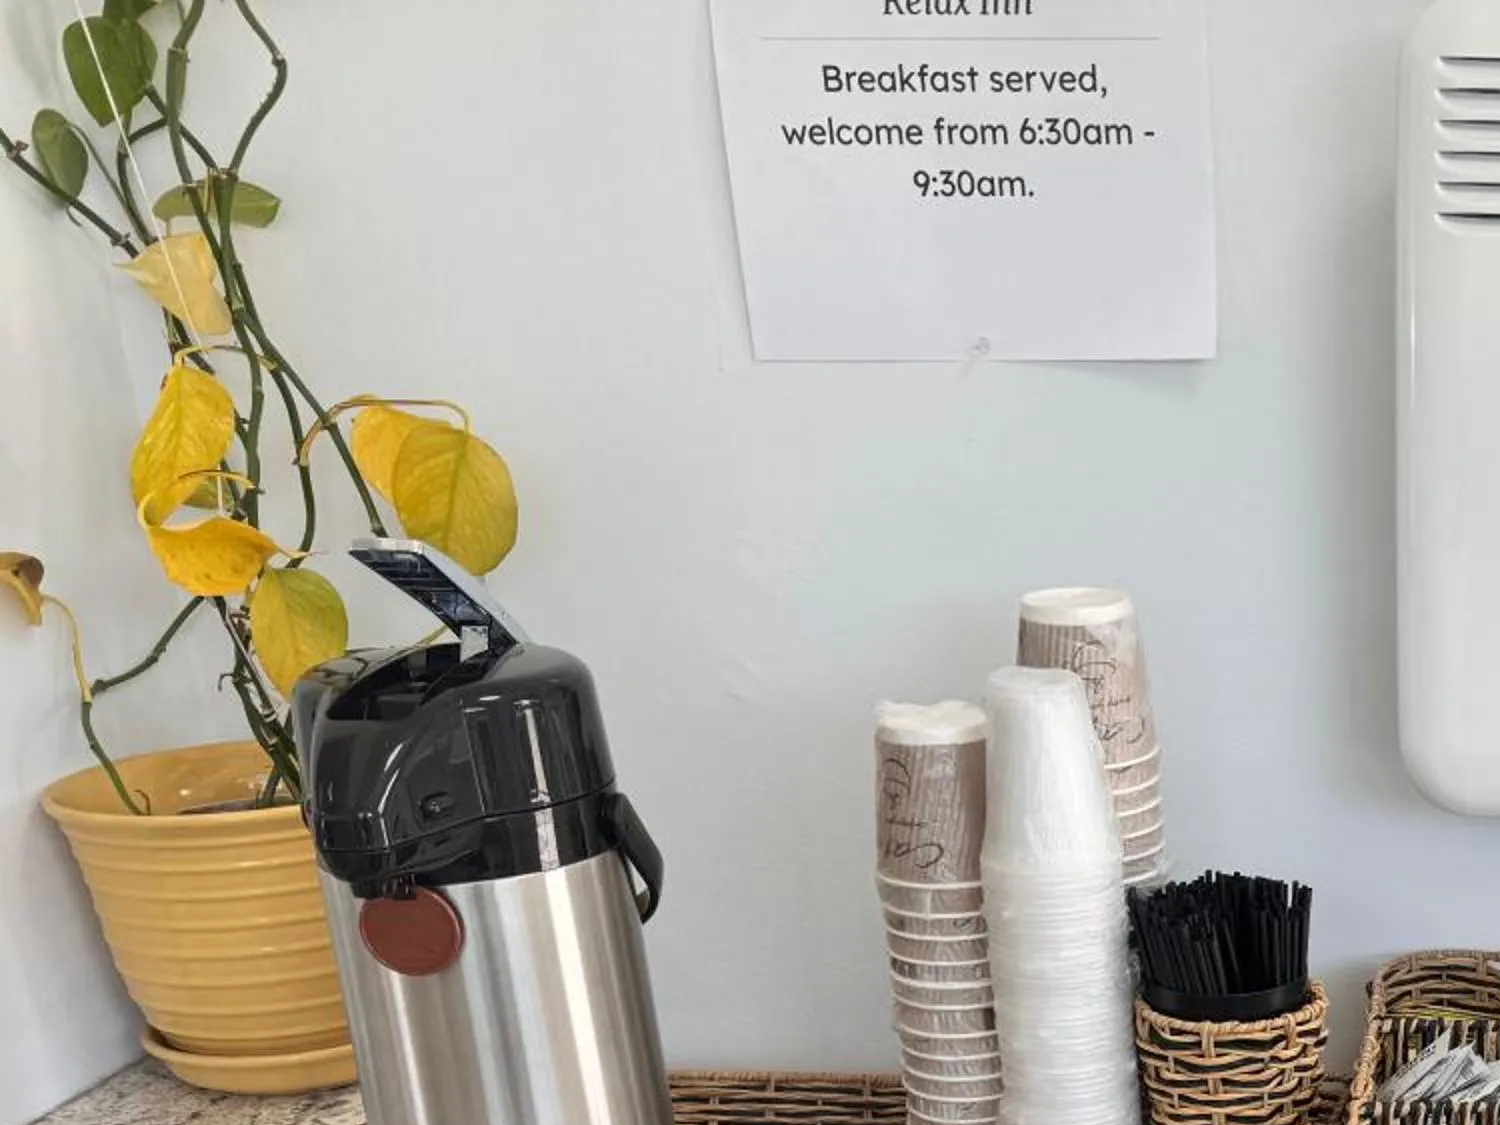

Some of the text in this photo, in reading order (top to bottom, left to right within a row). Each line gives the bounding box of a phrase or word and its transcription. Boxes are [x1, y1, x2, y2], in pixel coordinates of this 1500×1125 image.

[822, 64, 1107, 98] Breakfast served,
[781, 118, 923, 145] welcome
[934, 118, 1009, 145] from
[1019, 118, 1133, 145] 6:30am
[913, 170, 1034, 197] 9:30am.
